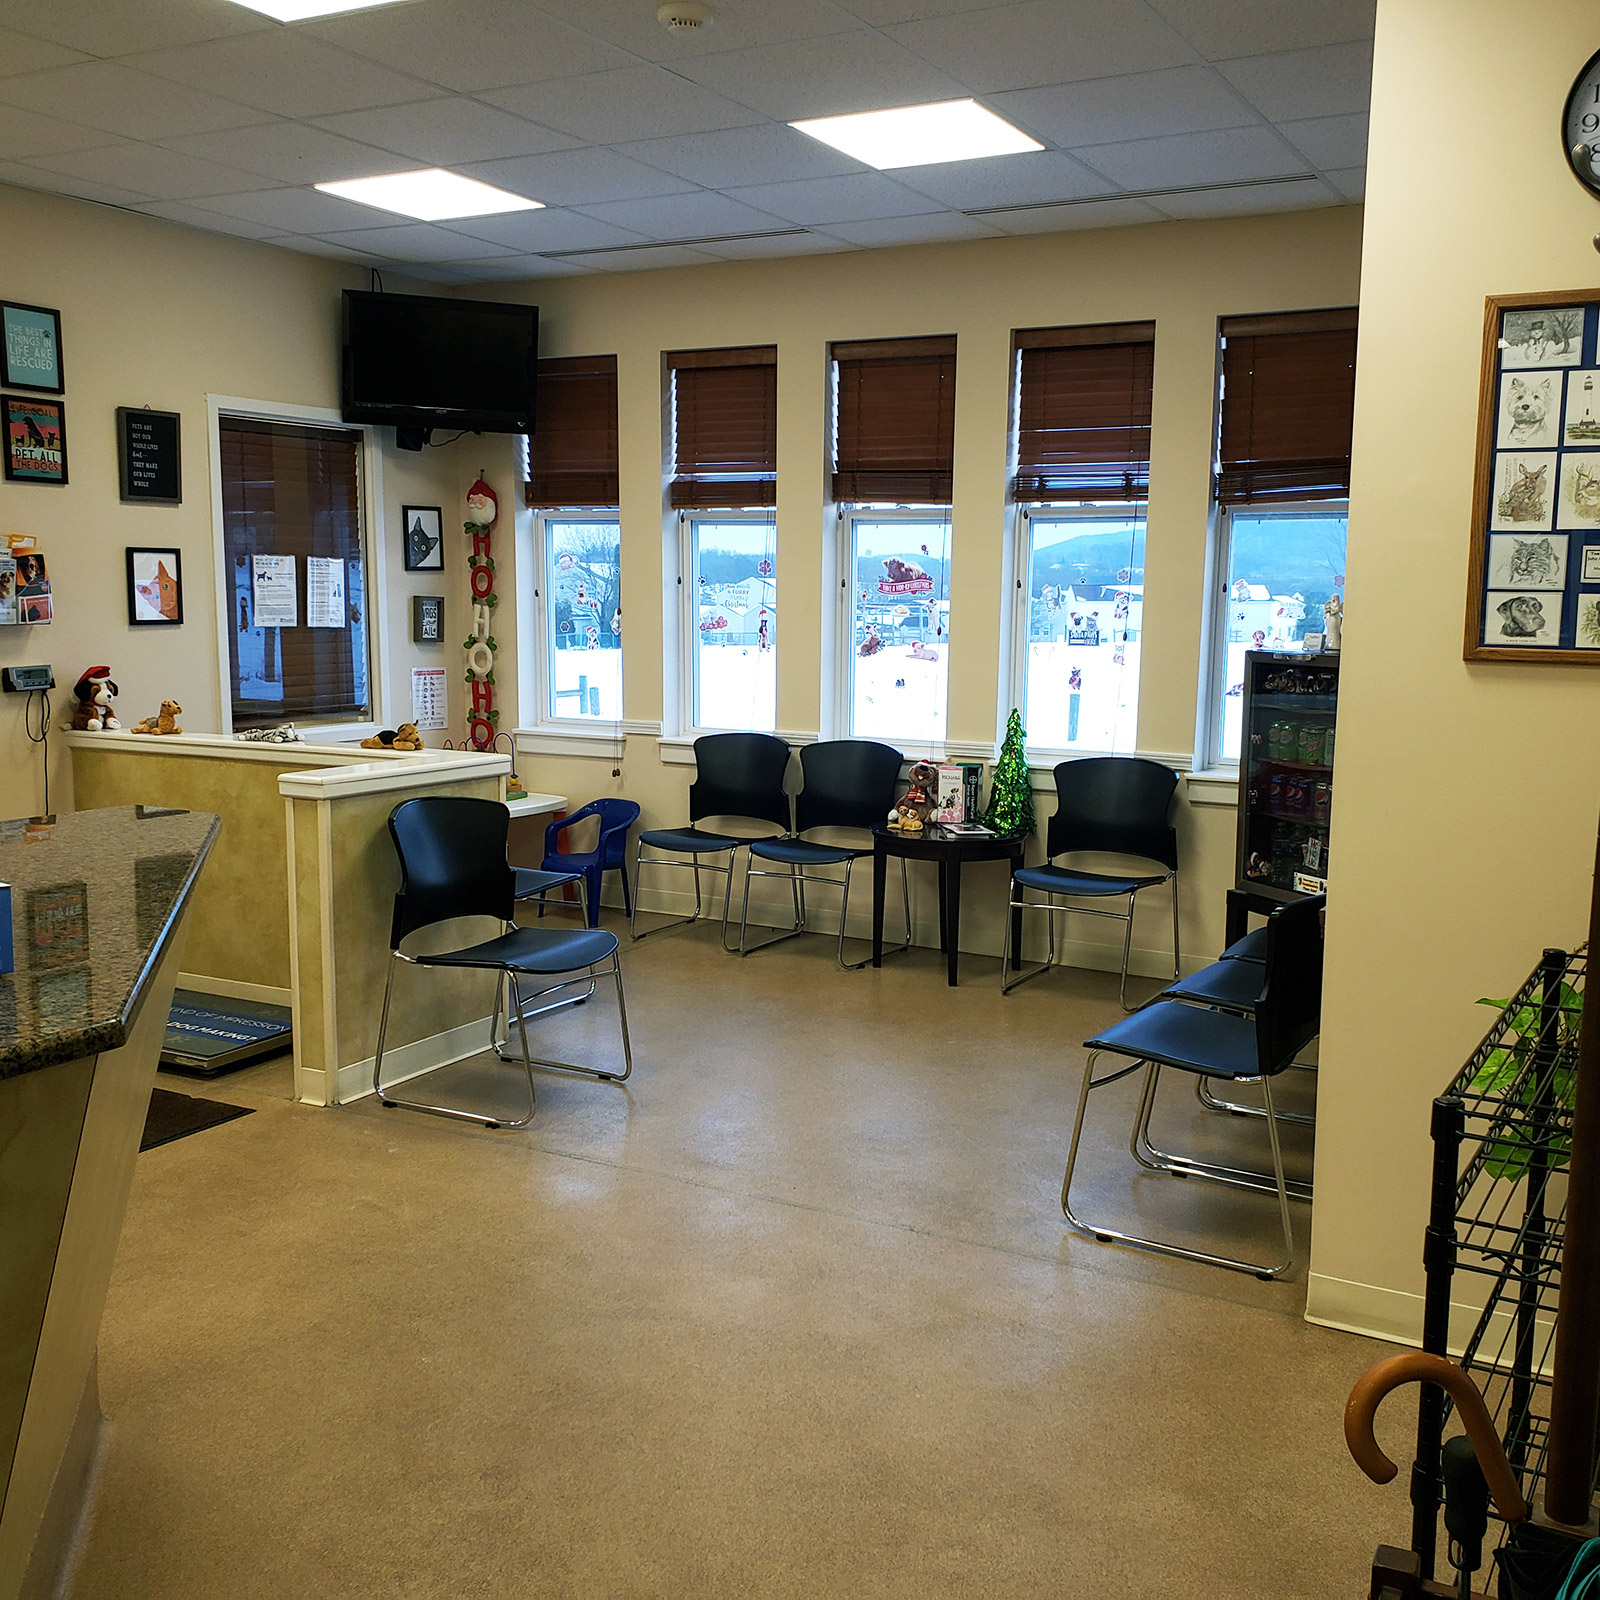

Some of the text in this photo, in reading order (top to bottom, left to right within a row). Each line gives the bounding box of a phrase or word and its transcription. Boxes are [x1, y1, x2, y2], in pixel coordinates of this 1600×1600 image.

[1581, 113, 1600, 133] 9
[9, 324, 44, 337] THE BEST
[9, 333, 52, 349] THINGS IN
[9, 343, 53, 360] LIFE ARE
[10, 355, 53, 370] RESCUED
[40, 450, 58, 463] ALL
[16, 460, 59, 471] THE DOGS
[196, 1011, 218, 1019] OF
[216, 1014, 291, 1032] IMPRESSION
[168, 1021, 258, 1041] DOG MAKING?
